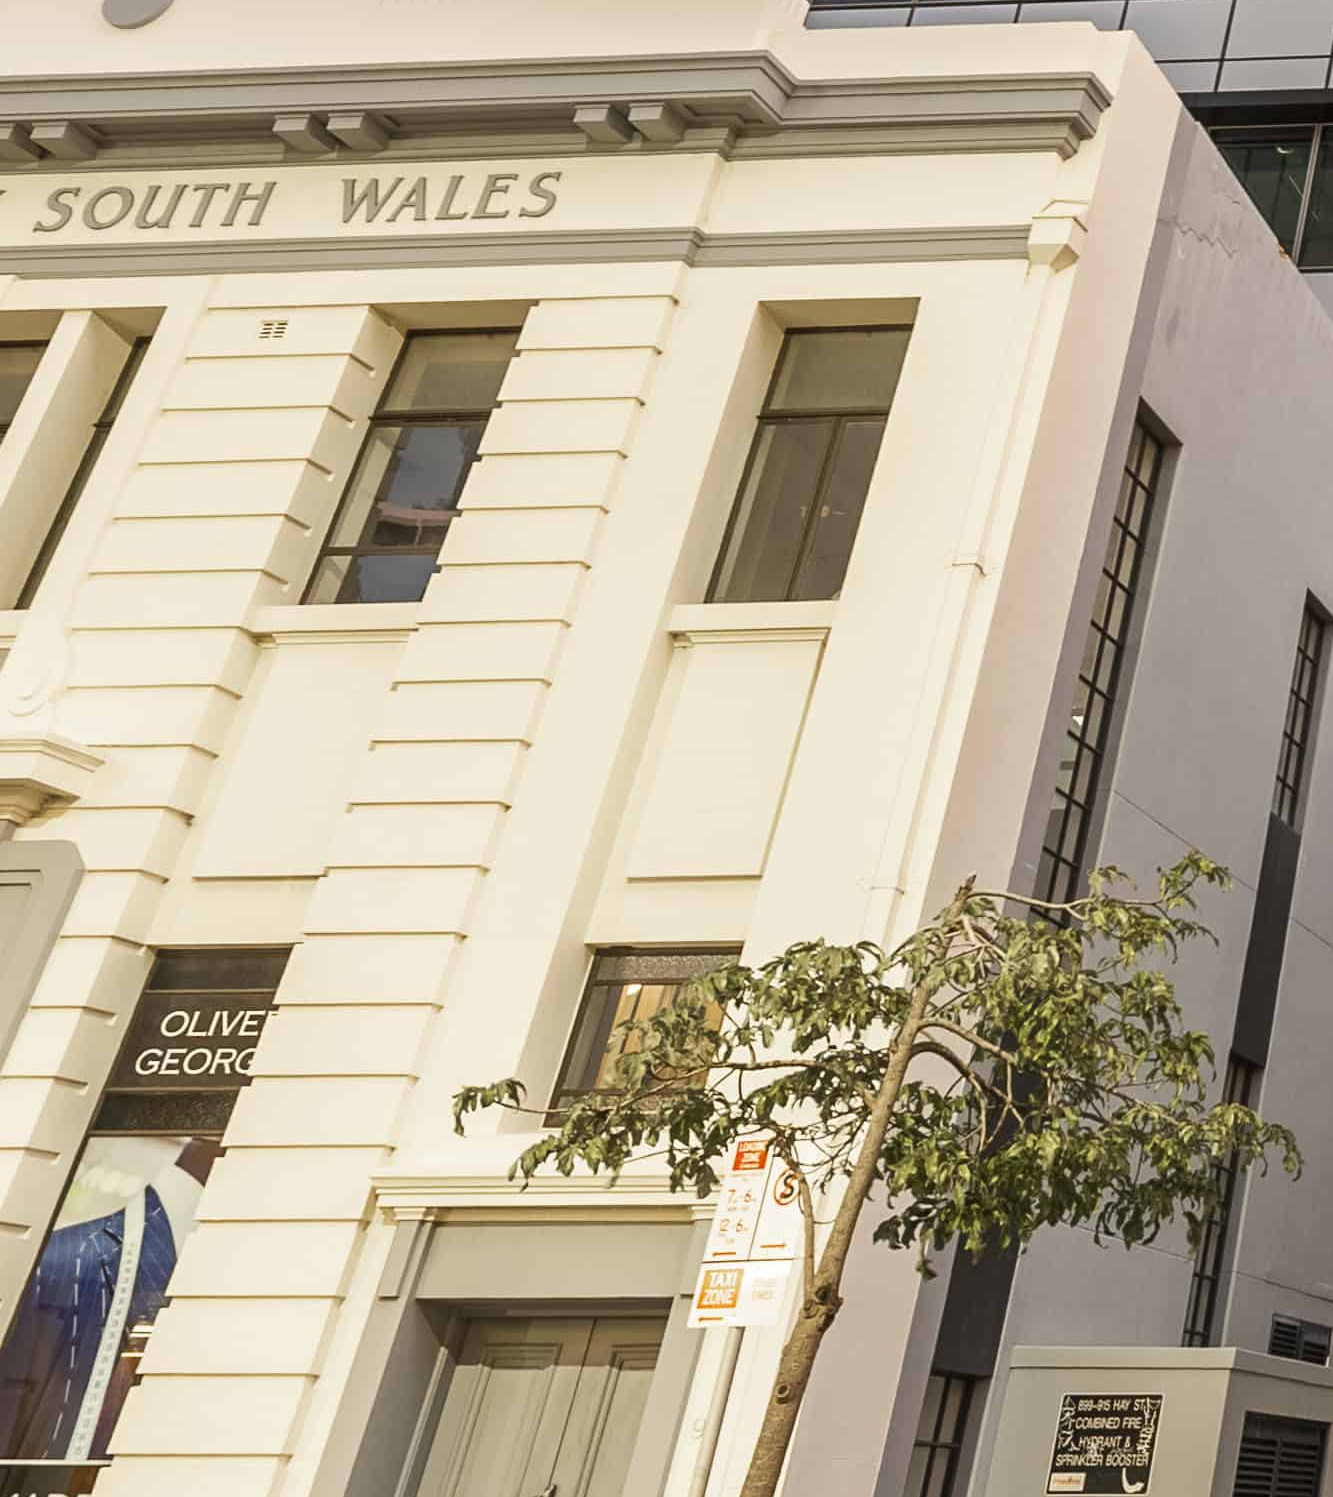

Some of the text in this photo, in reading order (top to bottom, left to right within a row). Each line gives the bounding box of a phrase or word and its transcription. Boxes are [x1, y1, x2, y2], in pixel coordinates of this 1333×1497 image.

[33, 171, 562, 233] SOUTH WALES
[709, 1271, 738, 1288] TAXI
[702, 1288, 737, 1305] ZONE
[1113, 1399, 1131, 1411] HAY
[1133, 1399, 1145, 1411] ST
[1075, 1416, 1142, 1430] COMBINED FIRE
[1079, 1435, 1122, 1448] HYDRANT
[1055, 1453, 1148, 1467] SPRINKLER BOOSTER
